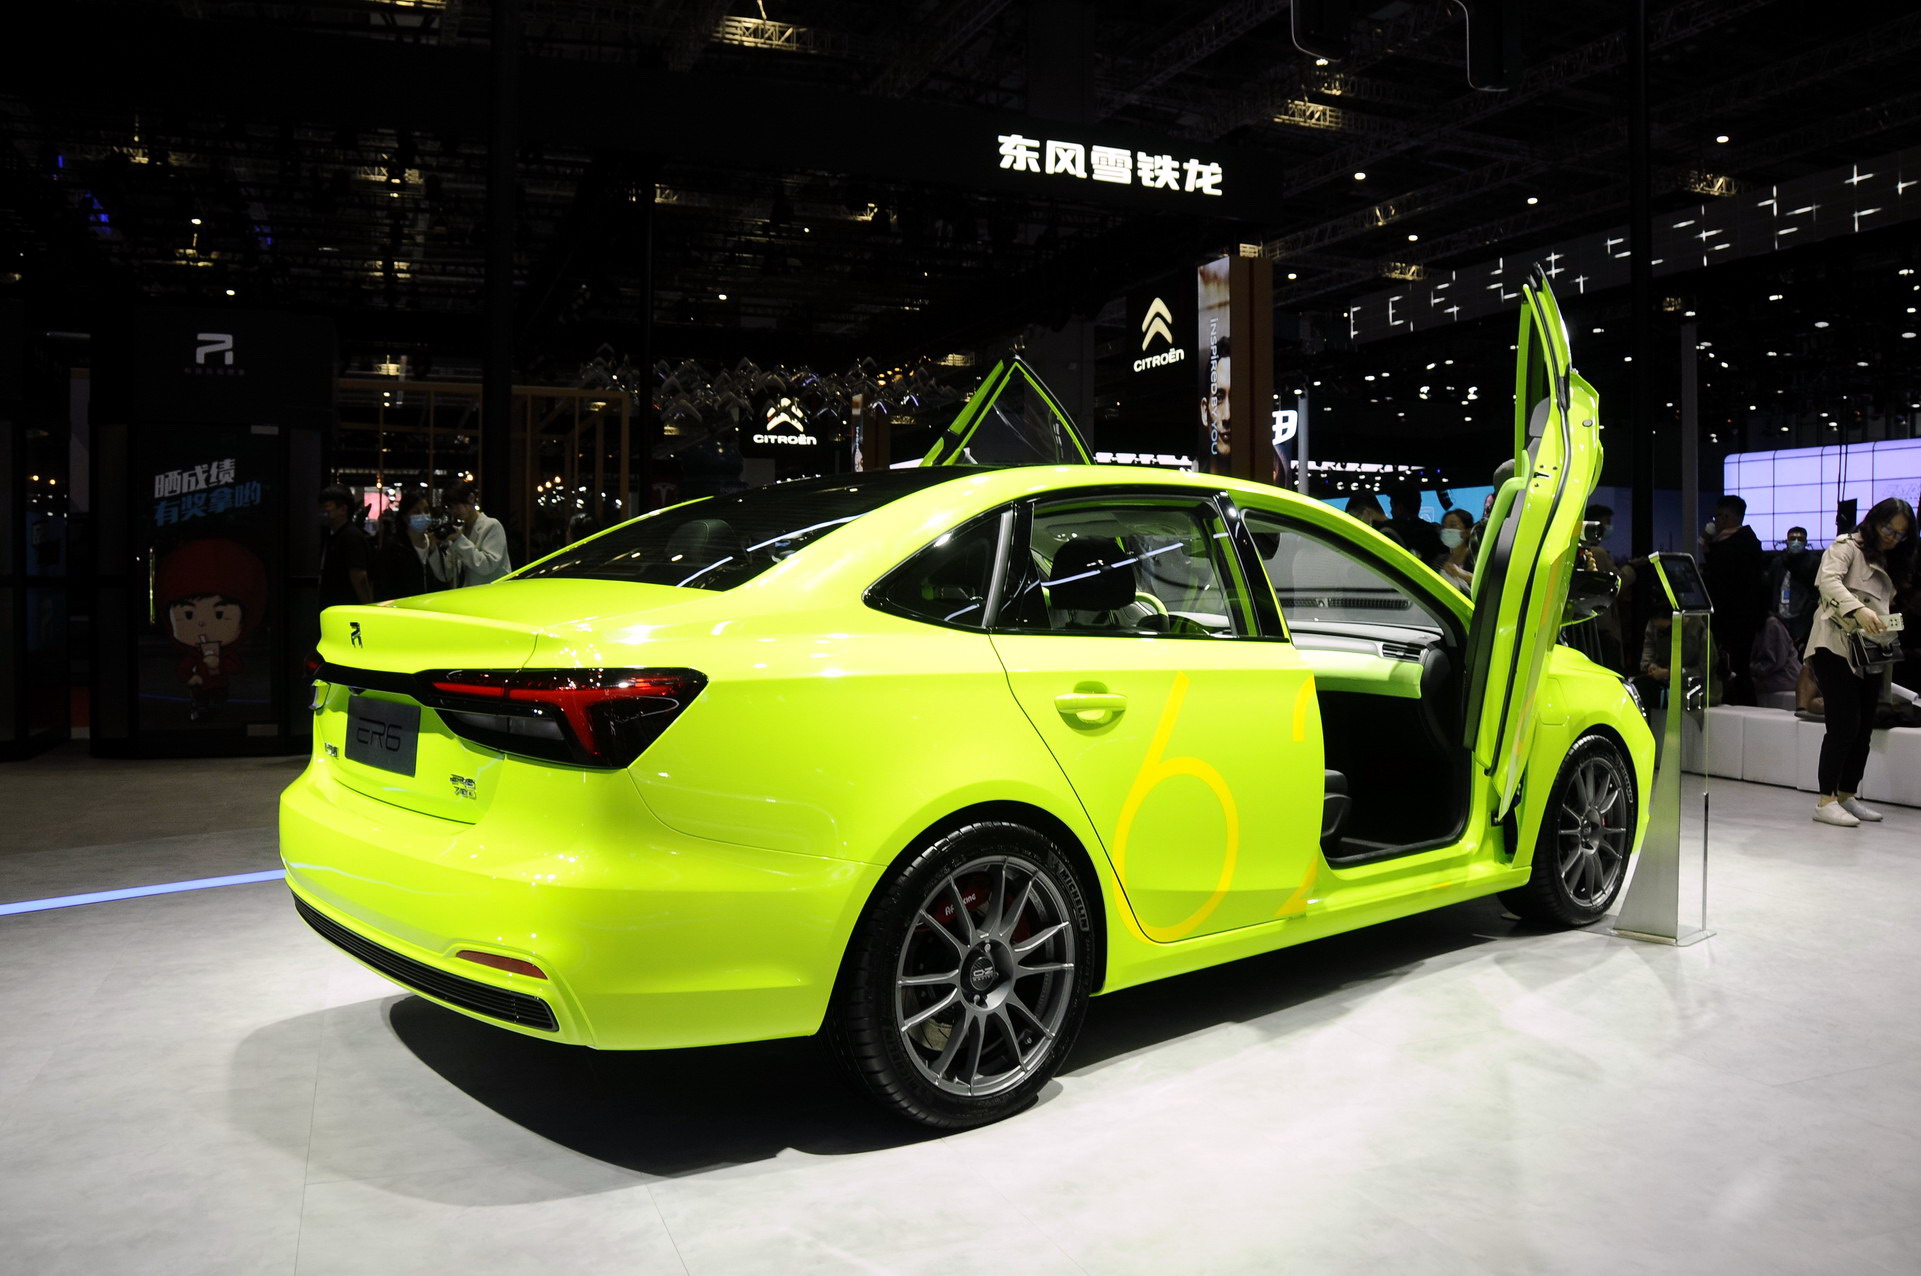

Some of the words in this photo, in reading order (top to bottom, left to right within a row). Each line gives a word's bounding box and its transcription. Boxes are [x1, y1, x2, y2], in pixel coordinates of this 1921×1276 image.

[997, 134, 1223, 196] 东风雪铁龙
[1210, 396, 1219, 417] BY
[1210, 420, 1219, 455] YOU
[154, 458, 236, 499] 晒成绩
[153, 480, 262, 528] 有奖拿哟
[356, 717, 403, 752] ER6
[1059, 868, 1089, 929] MICHELIN
